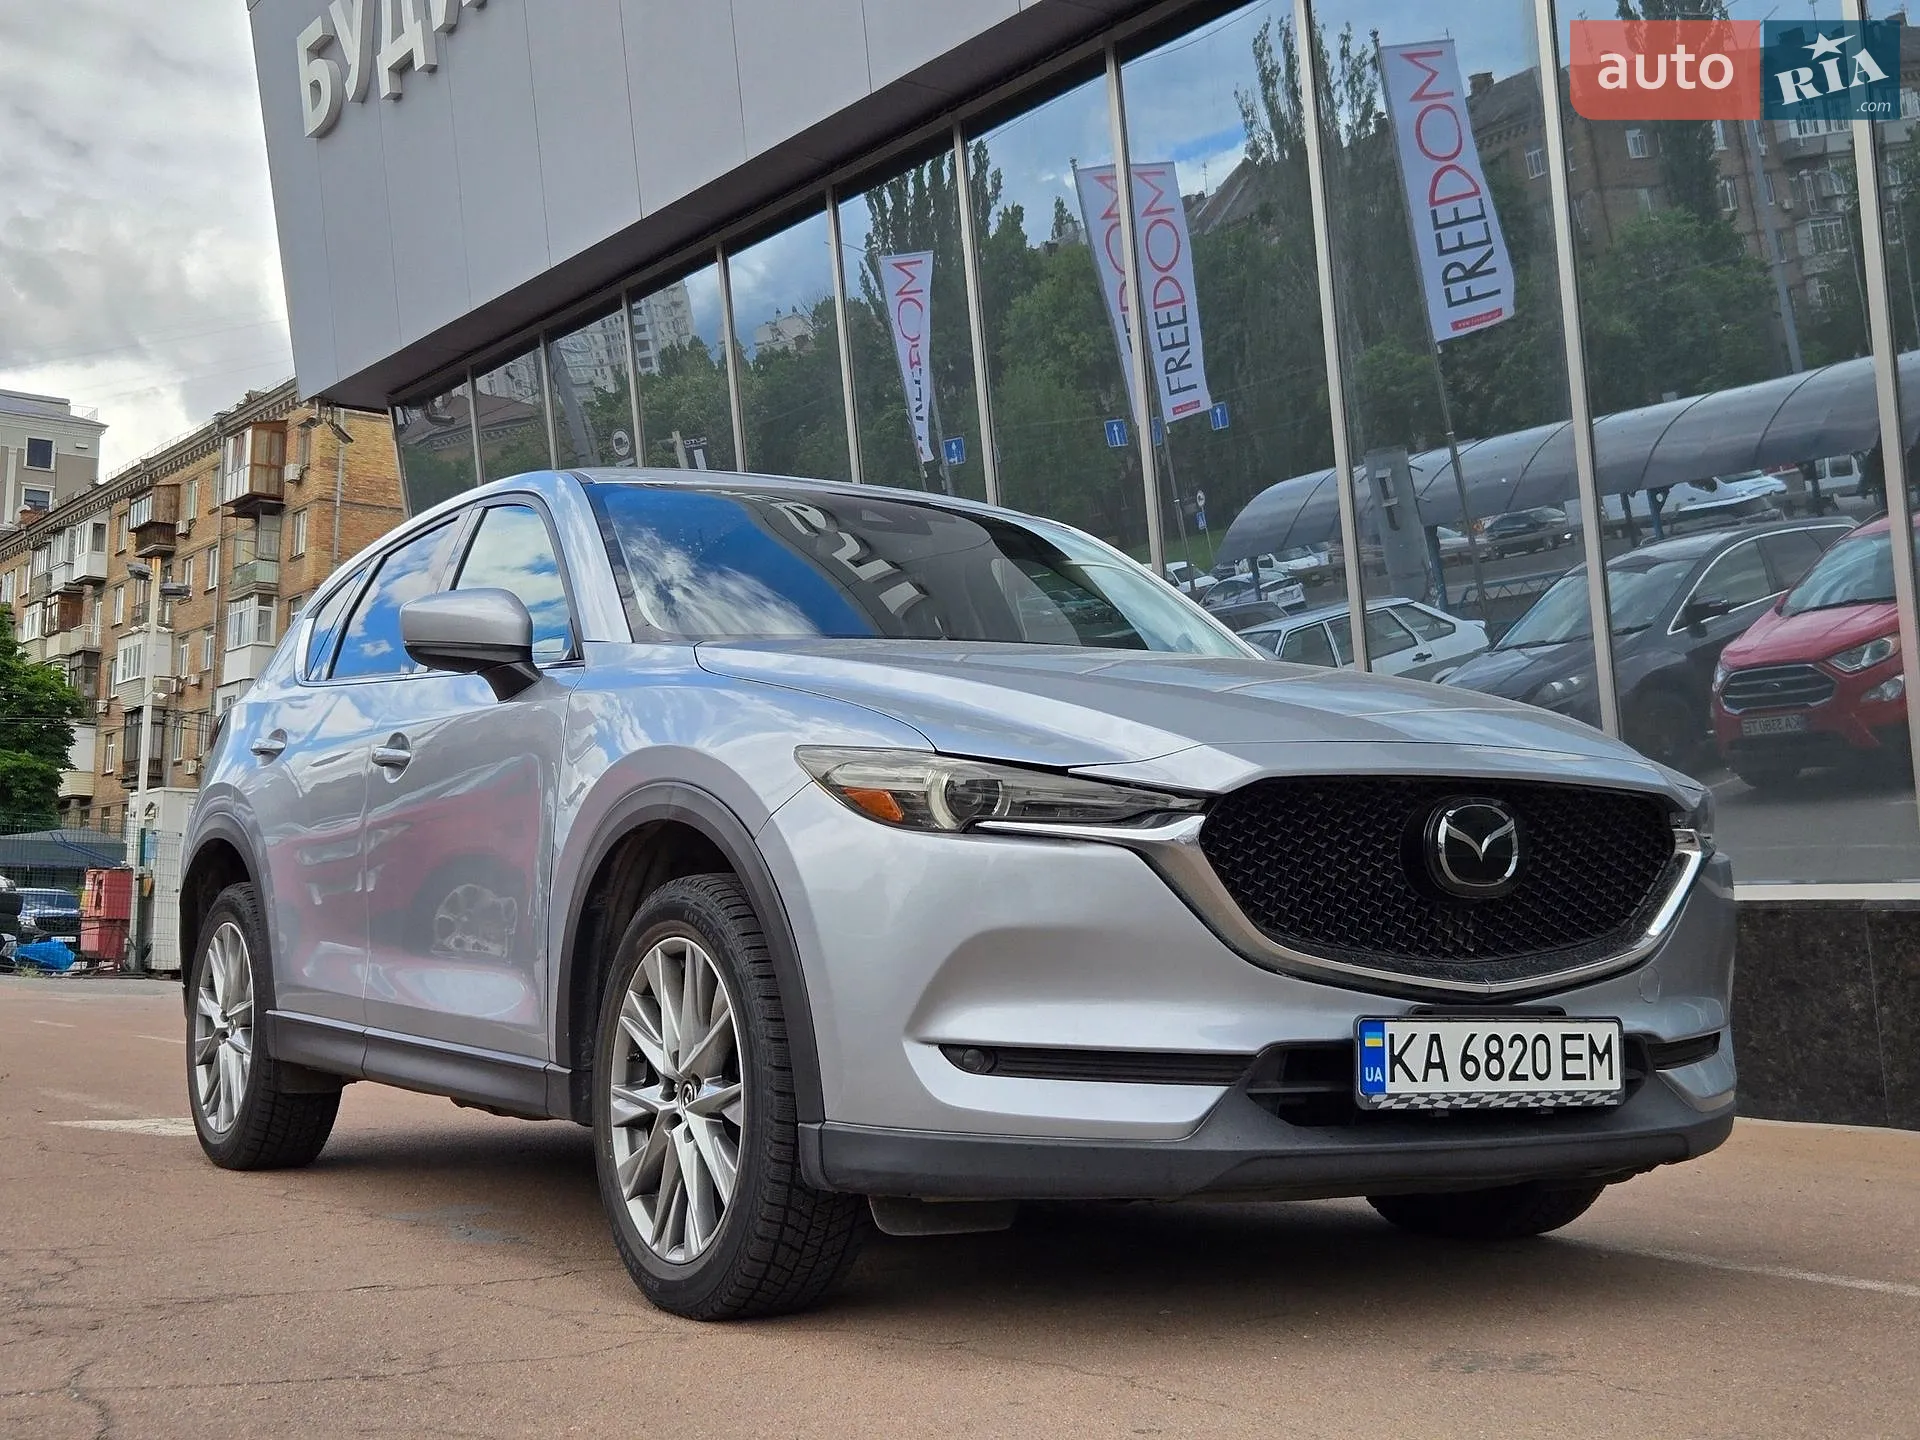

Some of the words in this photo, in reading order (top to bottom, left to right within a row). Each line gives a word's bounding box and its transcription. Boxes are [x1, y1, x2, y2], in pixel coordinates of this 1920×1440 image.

[1400, 50, 1501, 308] FREEDOM
[1134, 171, 1198, 396] FREEDOM
[1365, 1067, 1383, 1082] UA
[1388, 1033, 1449, 1083] KA
[1460, 1033, 1551, 1082] 6820
[1560, 1033, 1614, 1081] EM
